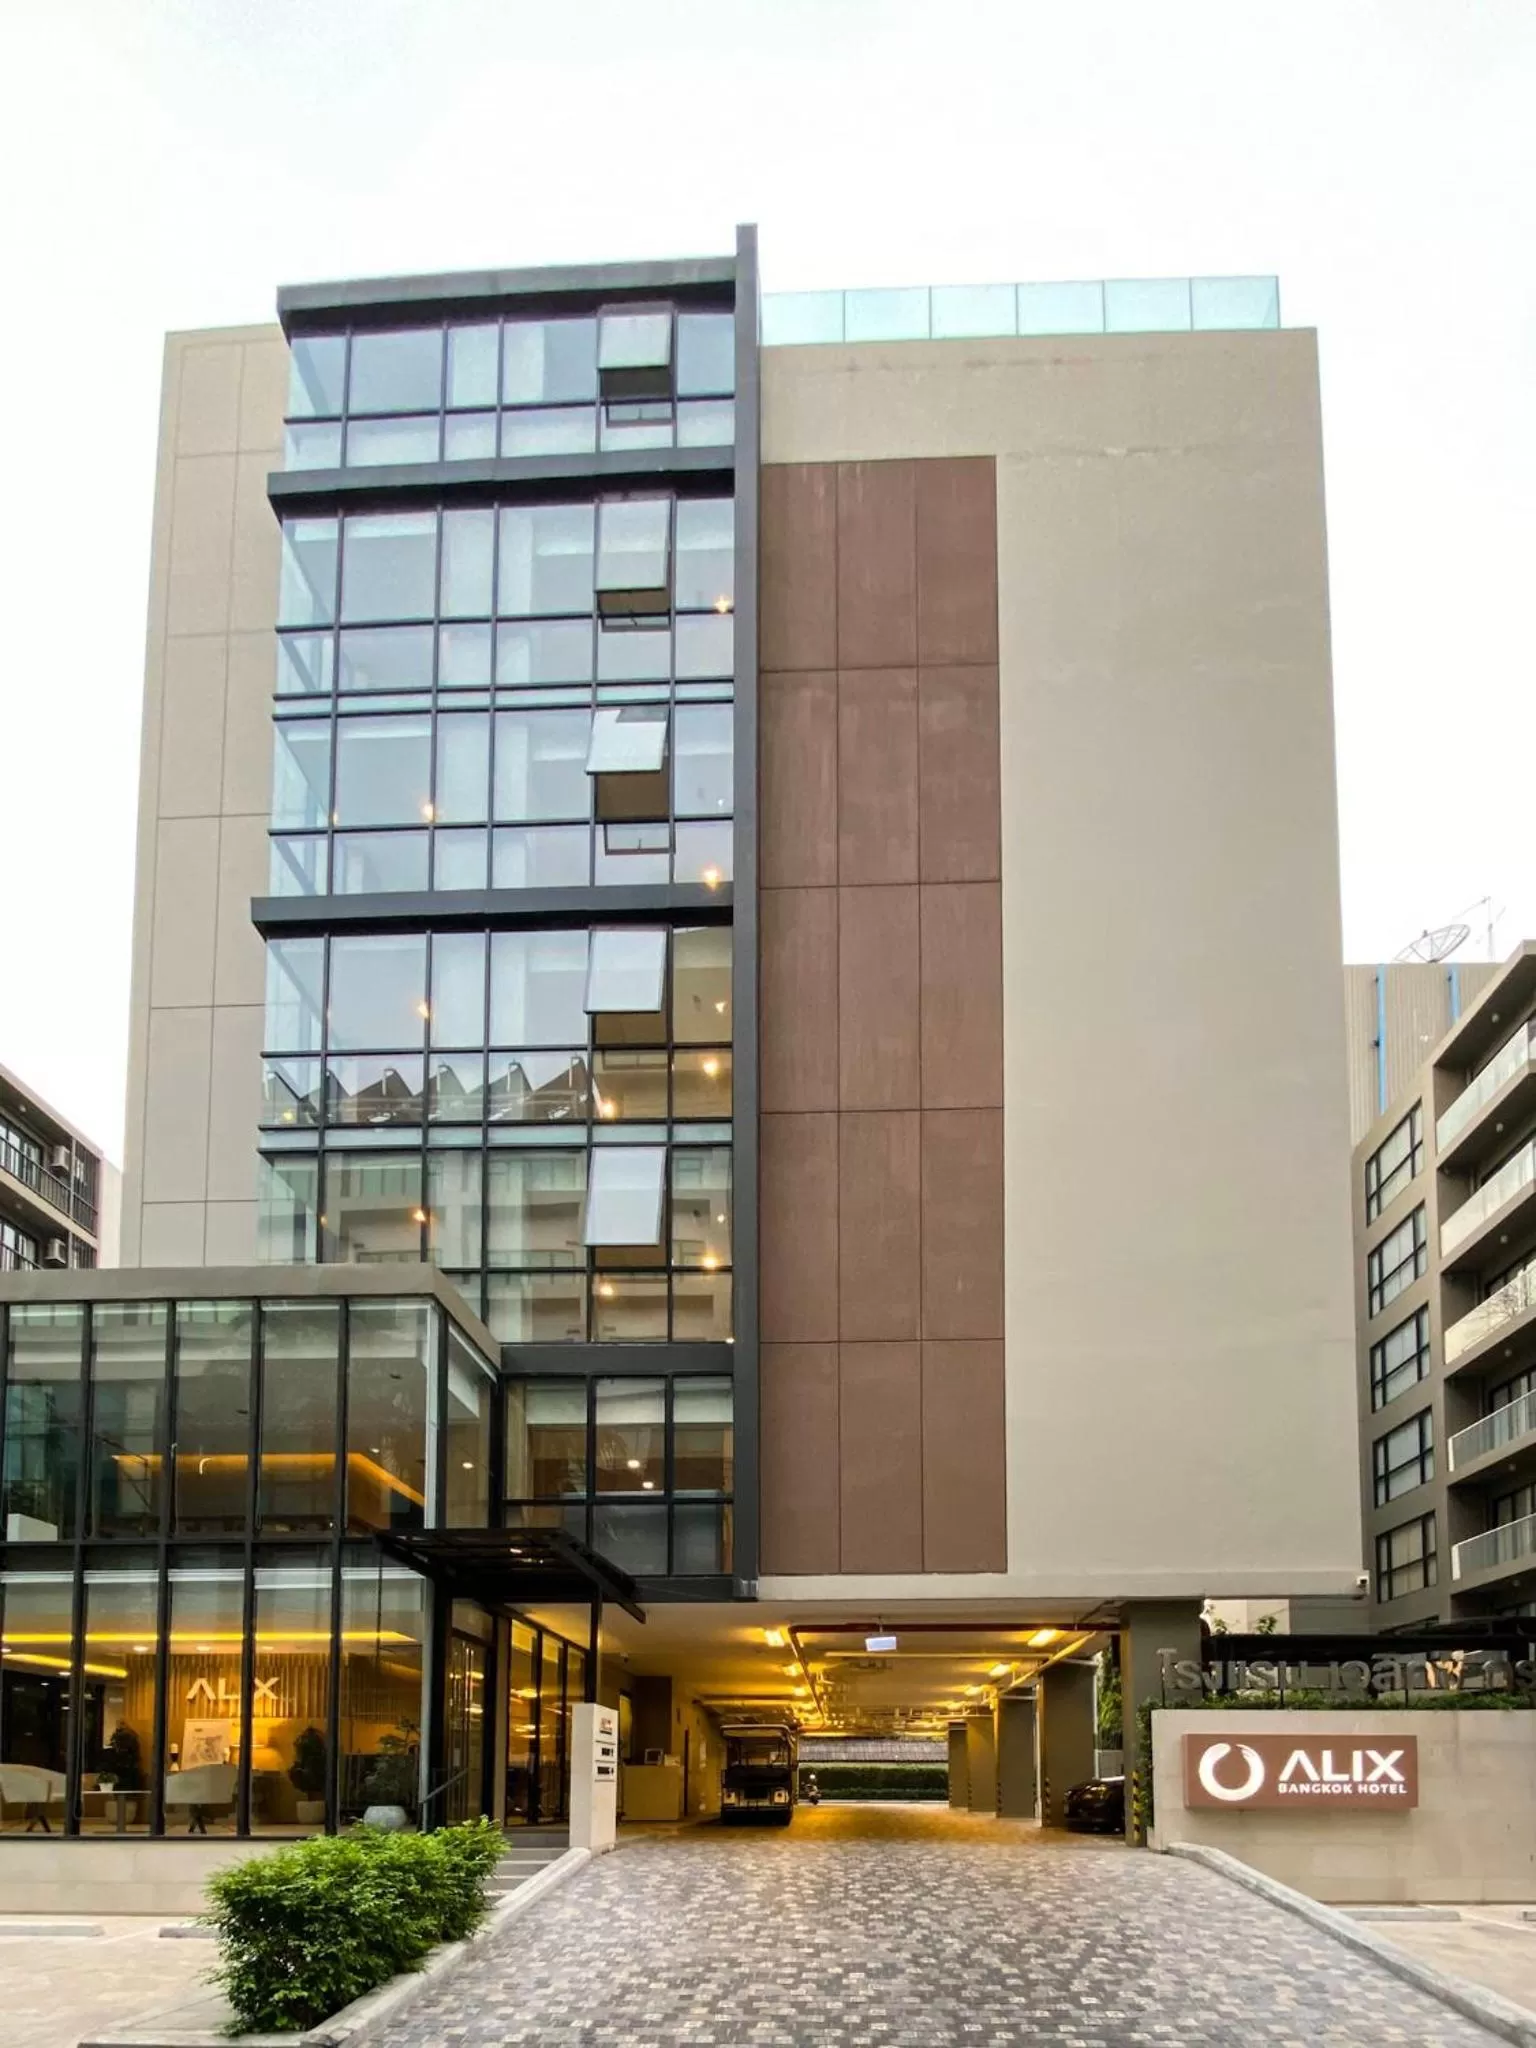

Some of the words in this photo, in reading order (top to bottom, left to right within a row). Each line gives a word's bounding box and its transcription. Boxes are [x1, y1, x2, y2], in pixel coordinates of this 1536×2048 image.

[186, 1677, 280, 1700] ALX
[1278, 1749, 1406, 1782] ALIX
[1278, 1783, 1353, 1795] BANGKOK
[1358, 1783, 1408, 1795] HOTEL
